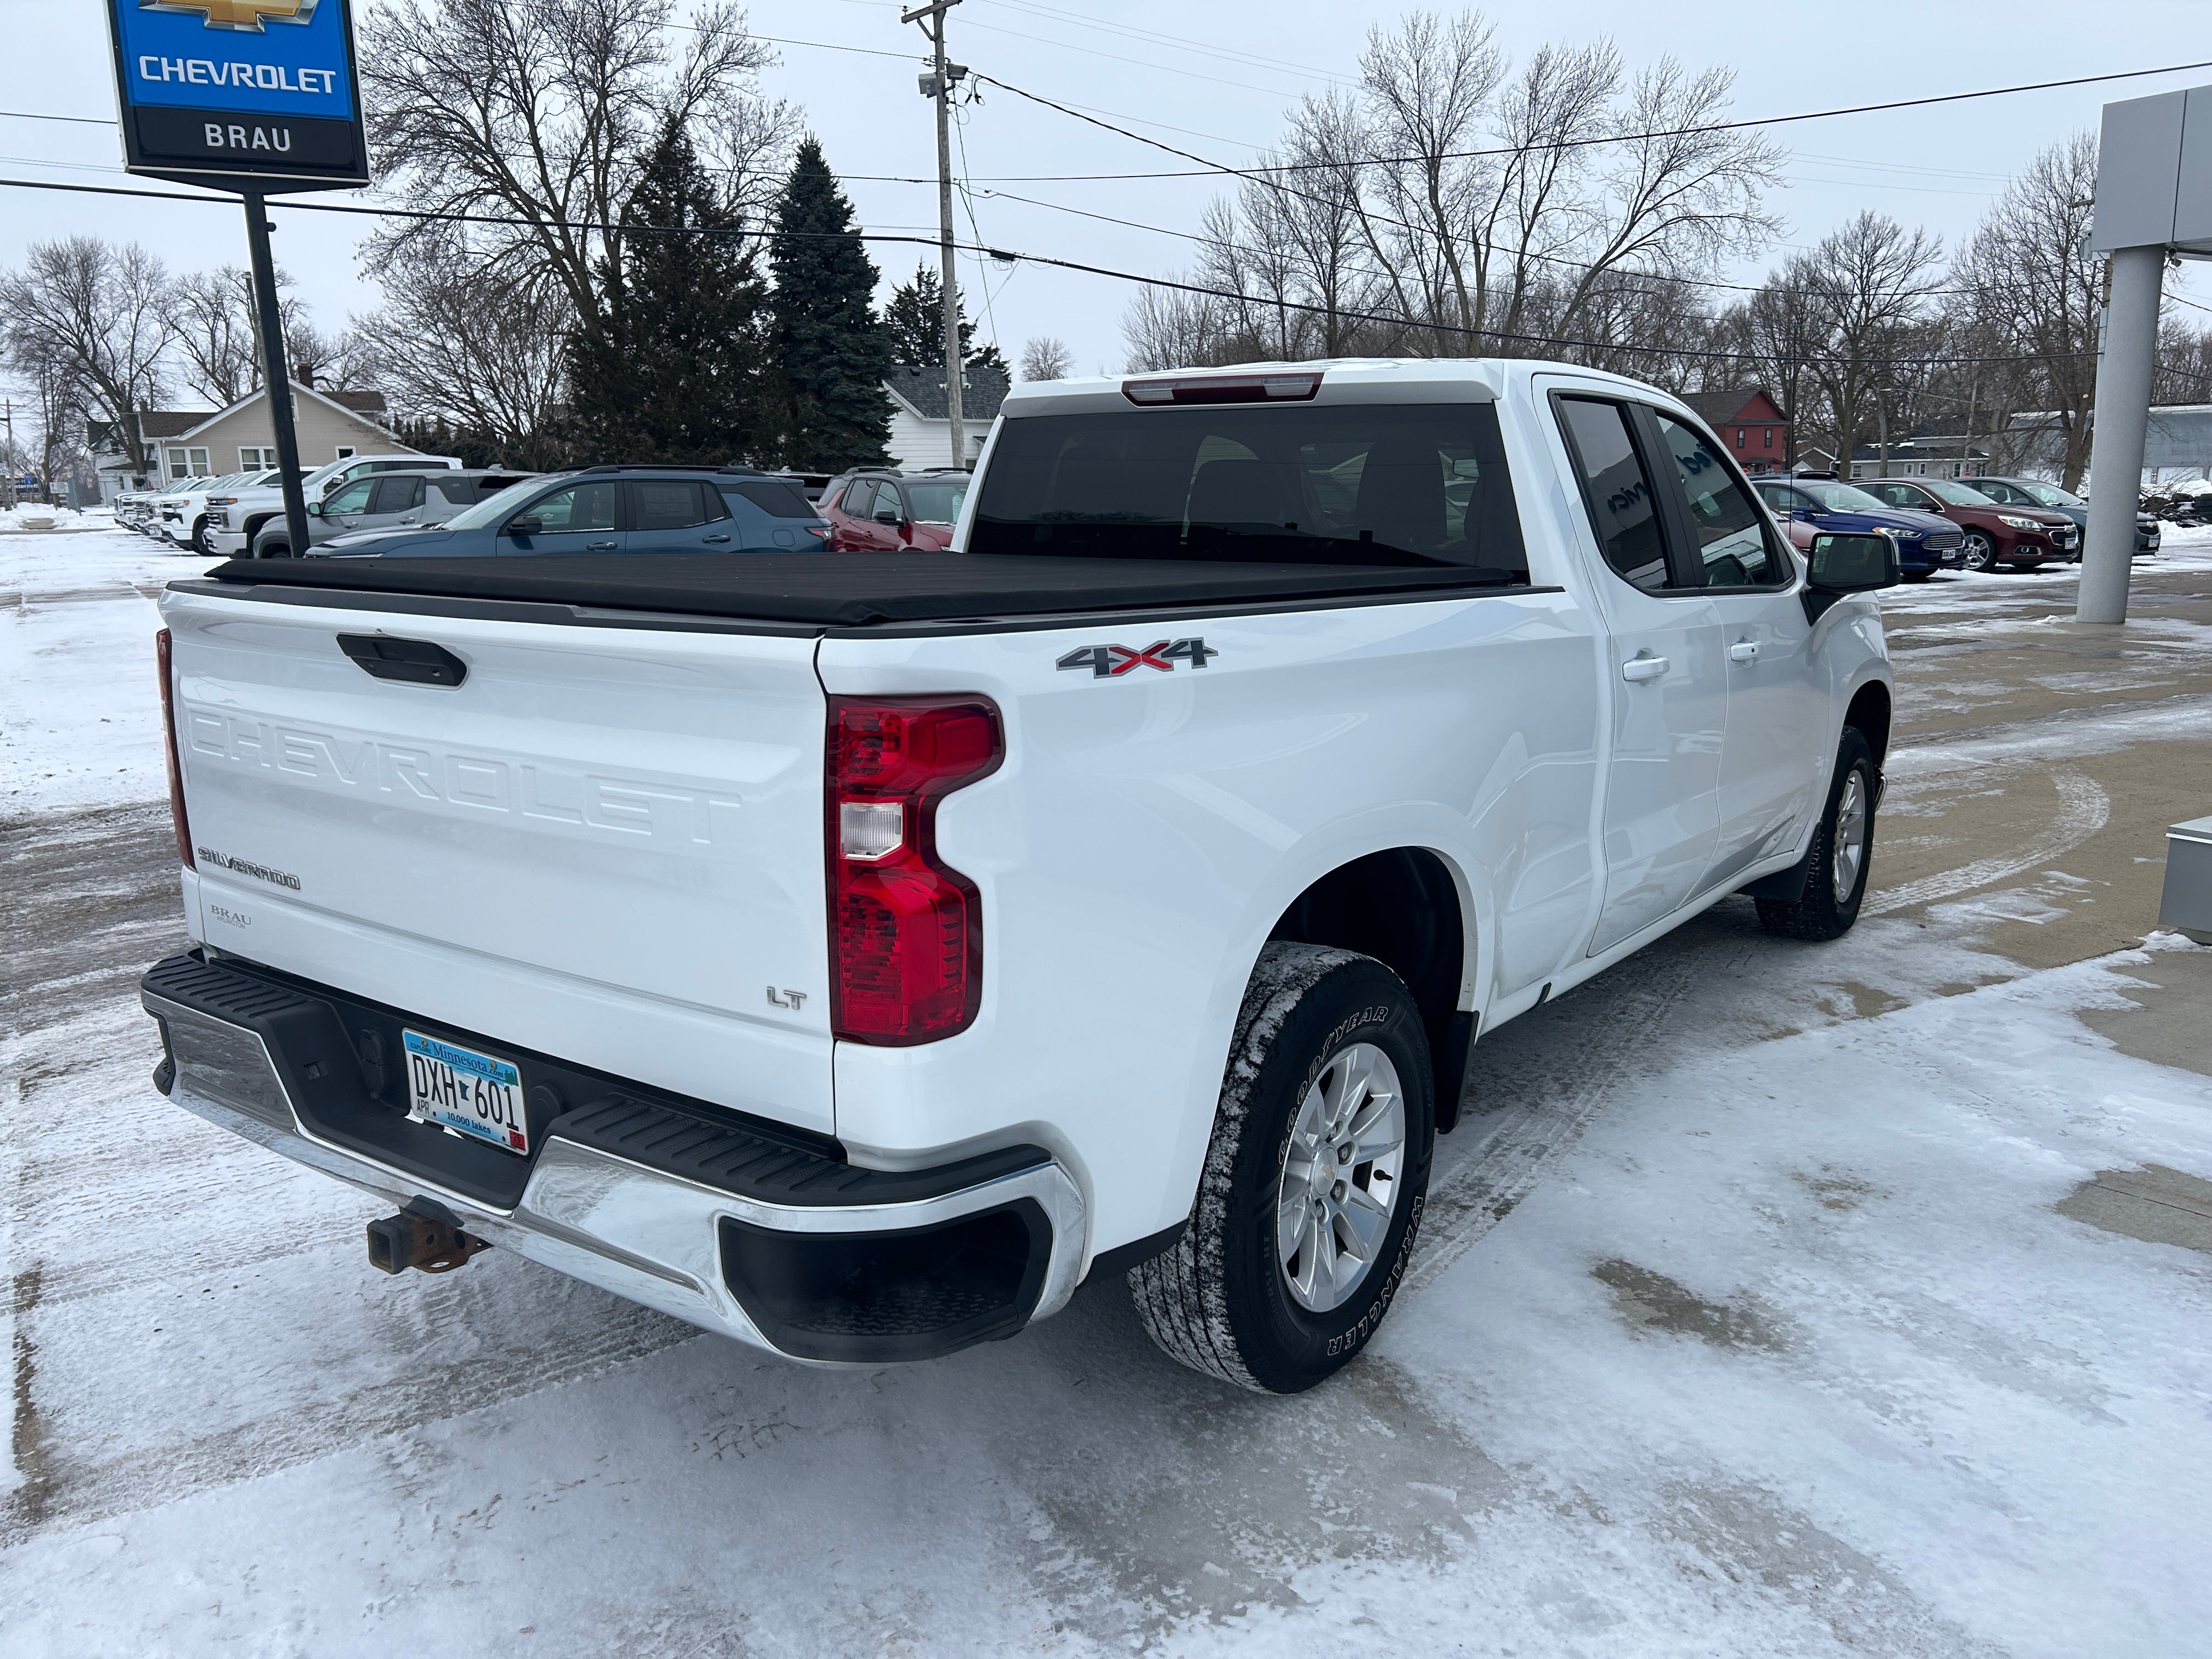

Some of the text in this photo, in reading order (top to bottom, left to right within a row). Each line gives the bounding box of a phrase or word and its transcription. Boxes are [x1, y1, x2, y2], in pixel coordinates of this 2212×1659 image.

[139, 55, 336, 94] CHEVROLET
[204, 123, 291, 152] BRAU
[188, 709, 742, 844] CHEVROLET
[198, 846, 301, 890] SILVERADO
[211, 904, 251, 925] BRAU
[217, 916, 246, 929] ARLINGTON
[766, 986, 807, 1010] LT
[412, 1054, 519, 1132] DXH 601
[1277, 1006, 1389, 1166] GOODYEAR
[417, 1098, 430, 1115] APR
[447, 1111, 491, 1134] 10,000 lakes
[1327, 1195, 1424, 1357] WRANGLER
